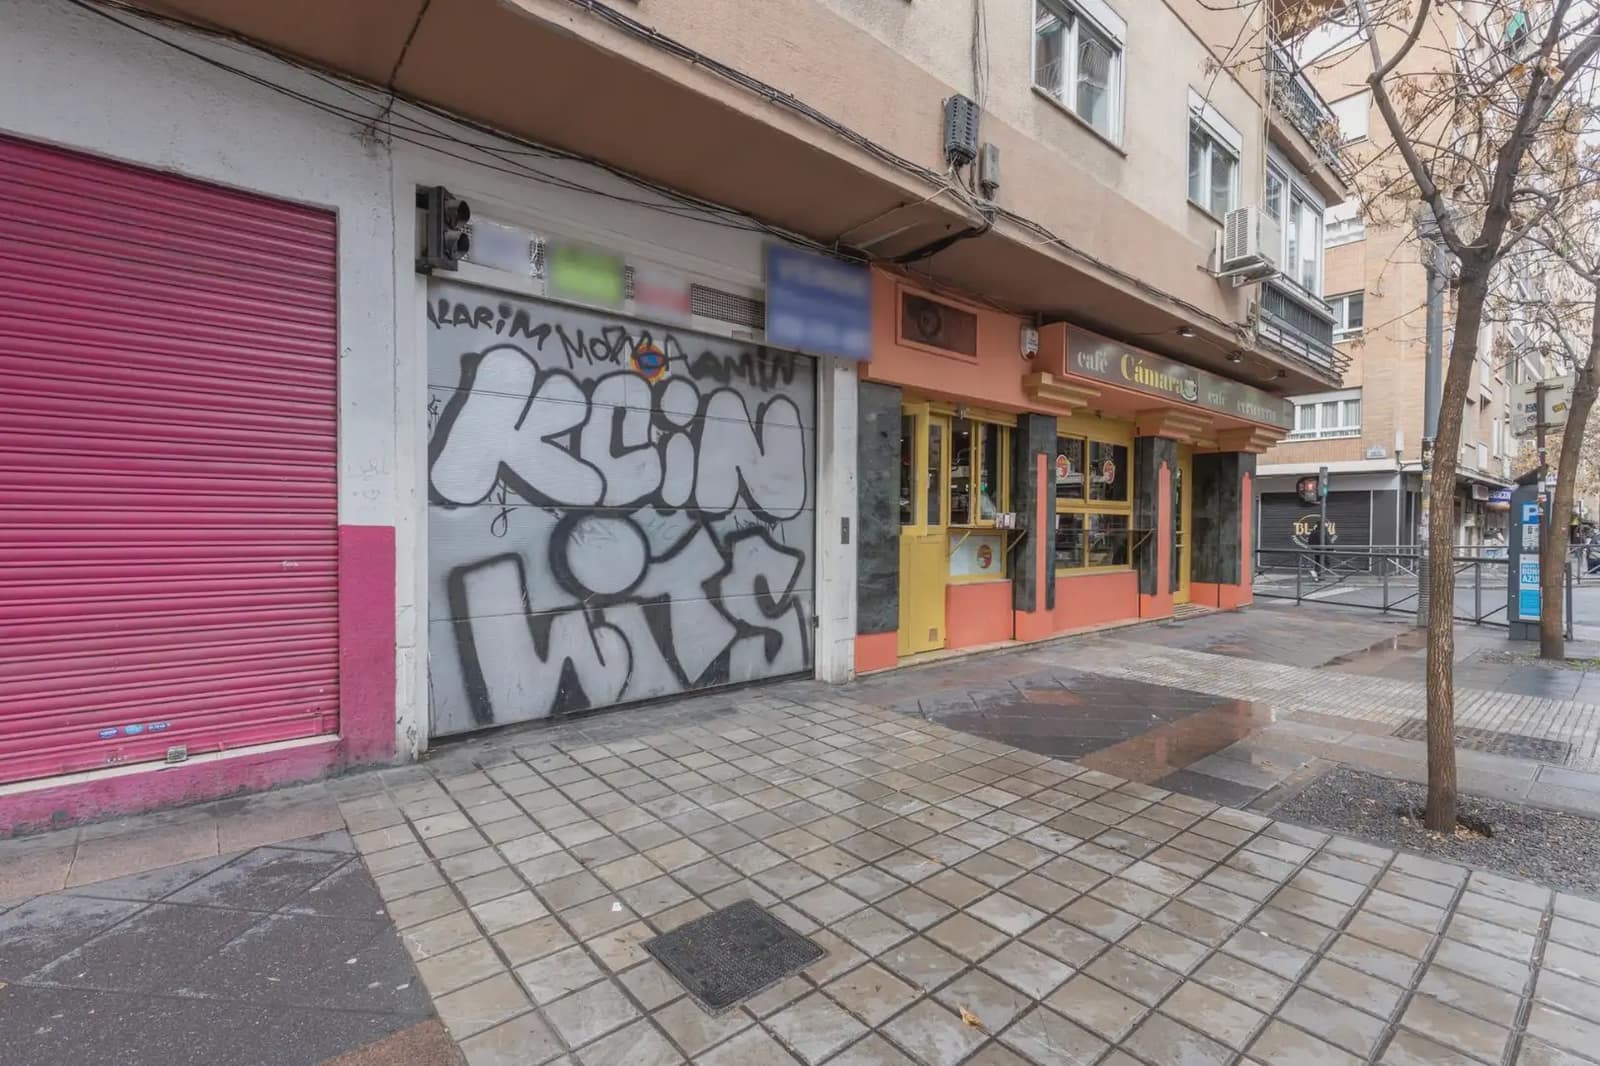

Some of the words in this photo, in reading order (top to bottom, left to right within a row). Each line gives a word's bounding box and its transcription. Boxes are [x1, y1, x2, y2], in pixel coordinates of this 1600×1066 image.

[1077, 350, 1109, 374] café
[1120, 353, 1185, 395] Cámara
[1522, 503, 1541, 522] P
